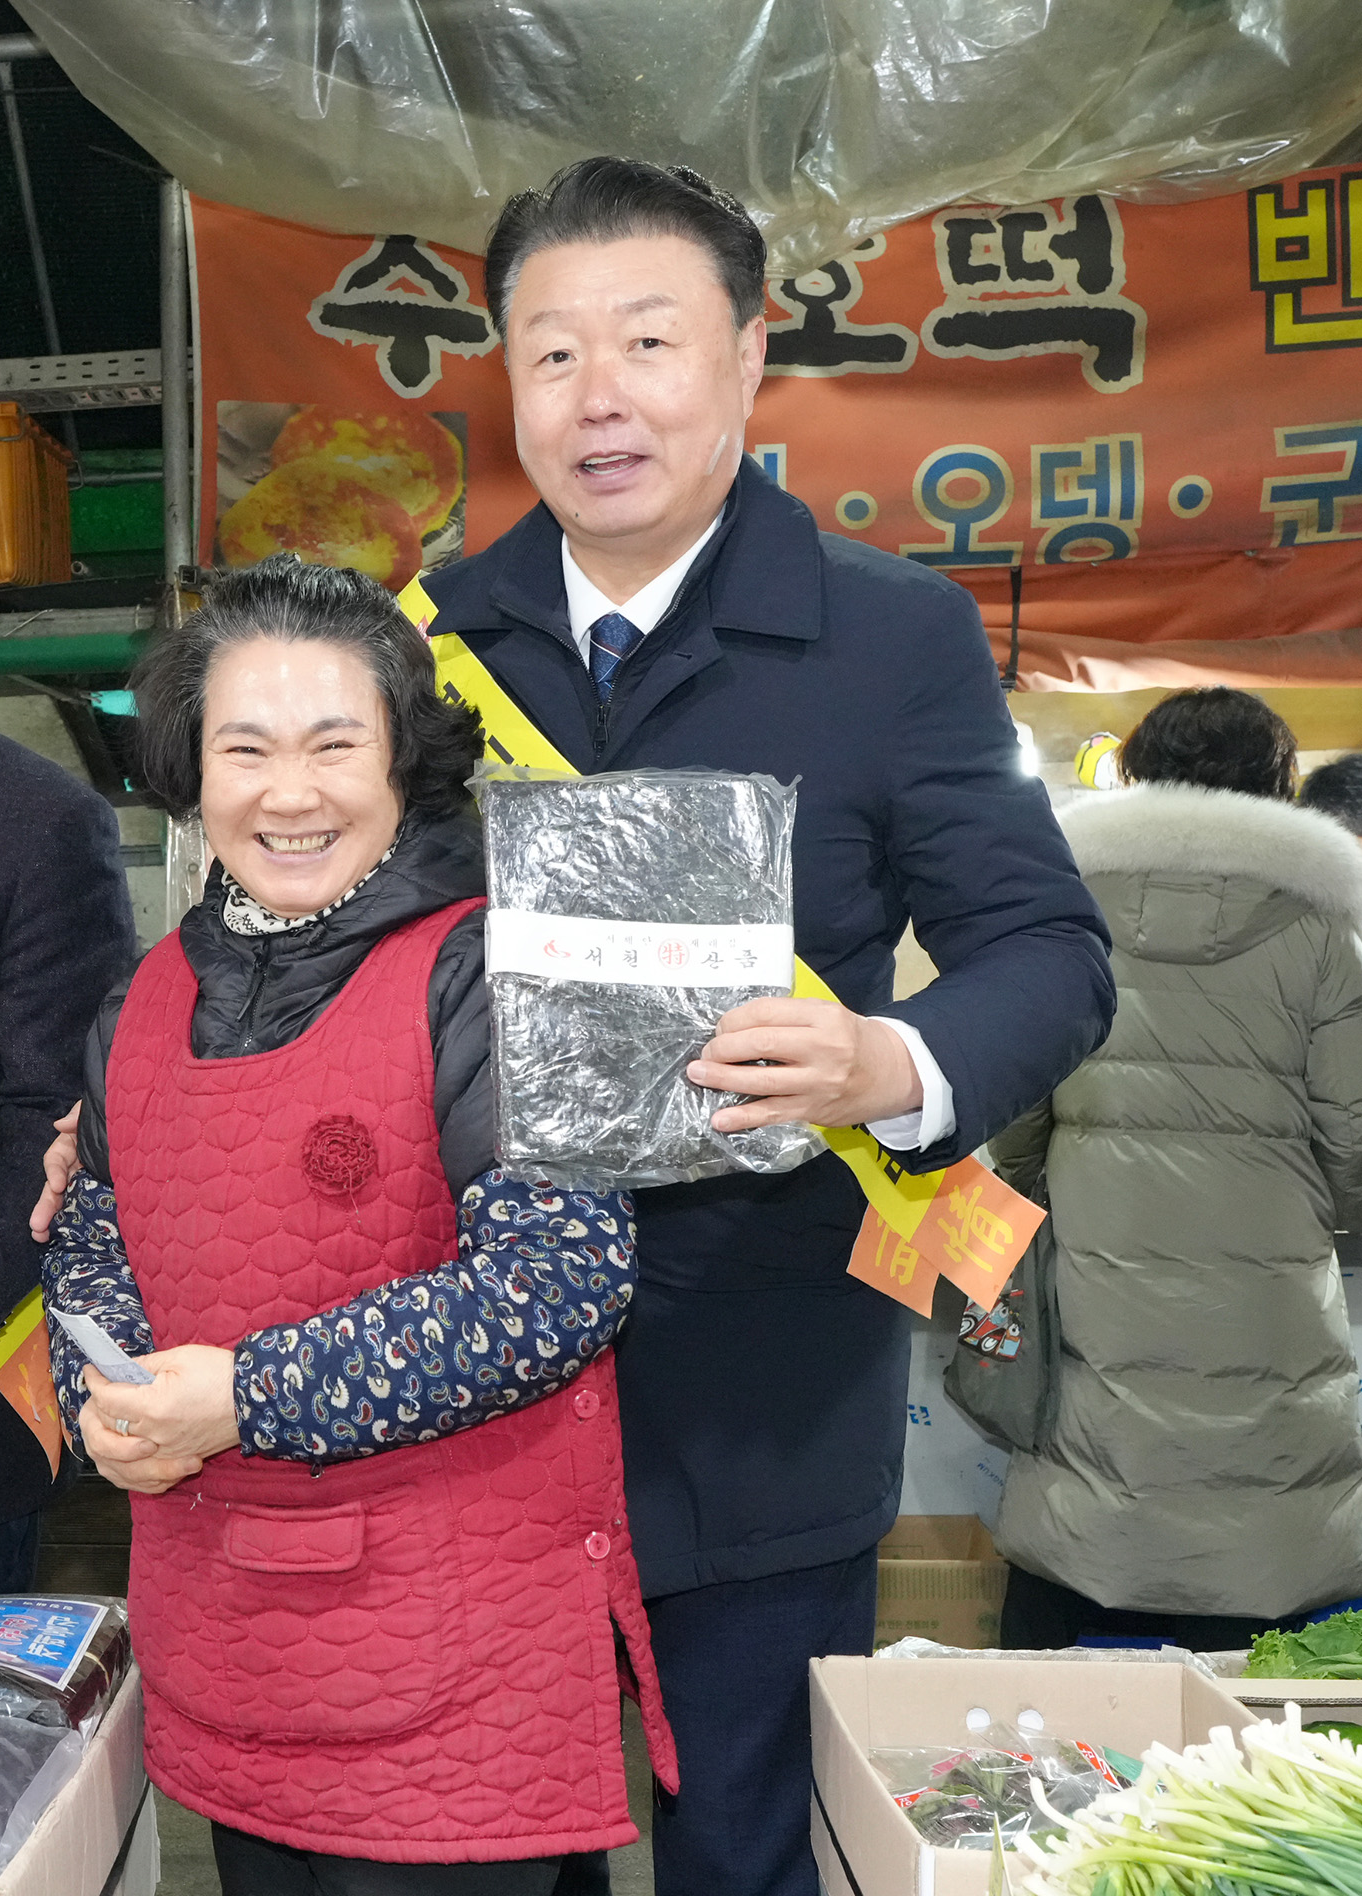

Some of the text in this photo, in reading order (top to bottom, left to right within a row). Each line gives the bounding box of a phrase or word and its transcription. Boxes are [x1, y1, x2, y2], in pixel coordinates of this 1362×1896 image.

[900, 433, 1144, 568] 오뎅
[661, 942, 687, 966] 特
[937, 1185, 1014, 1273] 情
